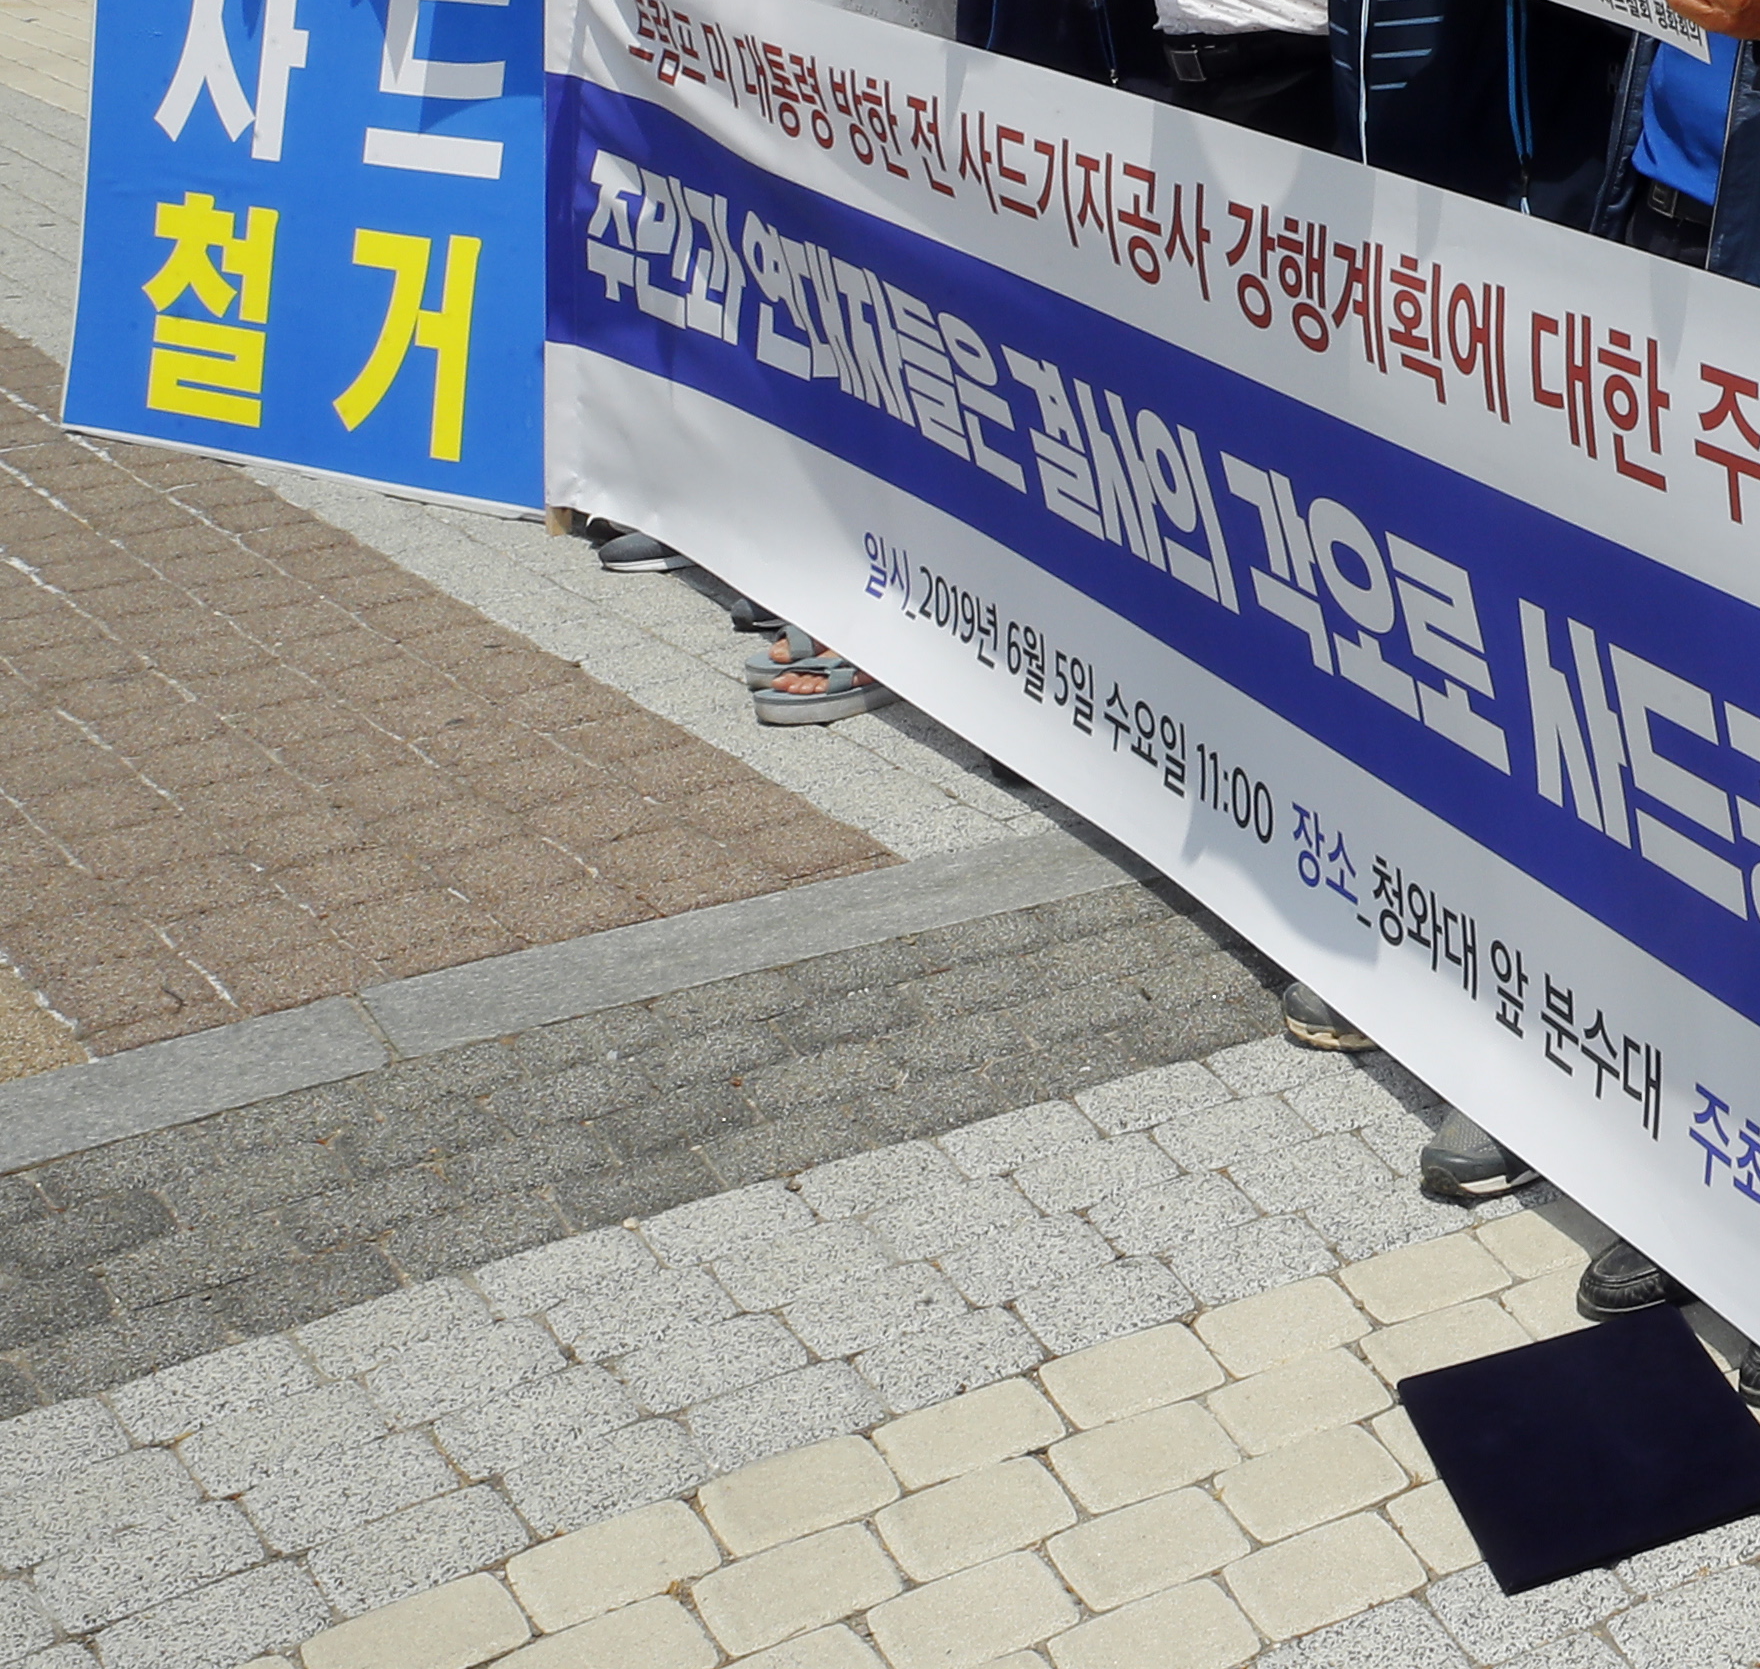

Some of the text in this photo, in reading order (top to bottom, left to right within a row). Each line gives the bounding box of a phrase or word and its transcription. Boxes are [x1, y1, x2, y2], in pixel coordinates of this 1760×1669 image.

[585, 148, 747, 346] 주민과
[743, 209, 1027, 494] 연대자들은
[1000, 343, 1240, 615] 결사의
[1220, 449, 1512, 776] 각오로
[706, 20, 740, 108] 미
[733, 34, 834, 150] 대통령
[829, 66, 909, 181] 방한
[906, 95, 956, 198] 전
[958, 111, 1211, 302] 사드기지공사
[1224, 198, 1512, 425] 강행계획에
[1530, 311, 1670, 494] 대한
[1005, 624, 1046, 704] 6월
[1053, 652, 1096, 734] 5일
[1103, 691, 1189, 798] 수요일
[1196, 744, 1274, 844] 11:00
[1488, 939, 1530, 1039] 앞
[1539, 976, 1662, 1140] 분수대
